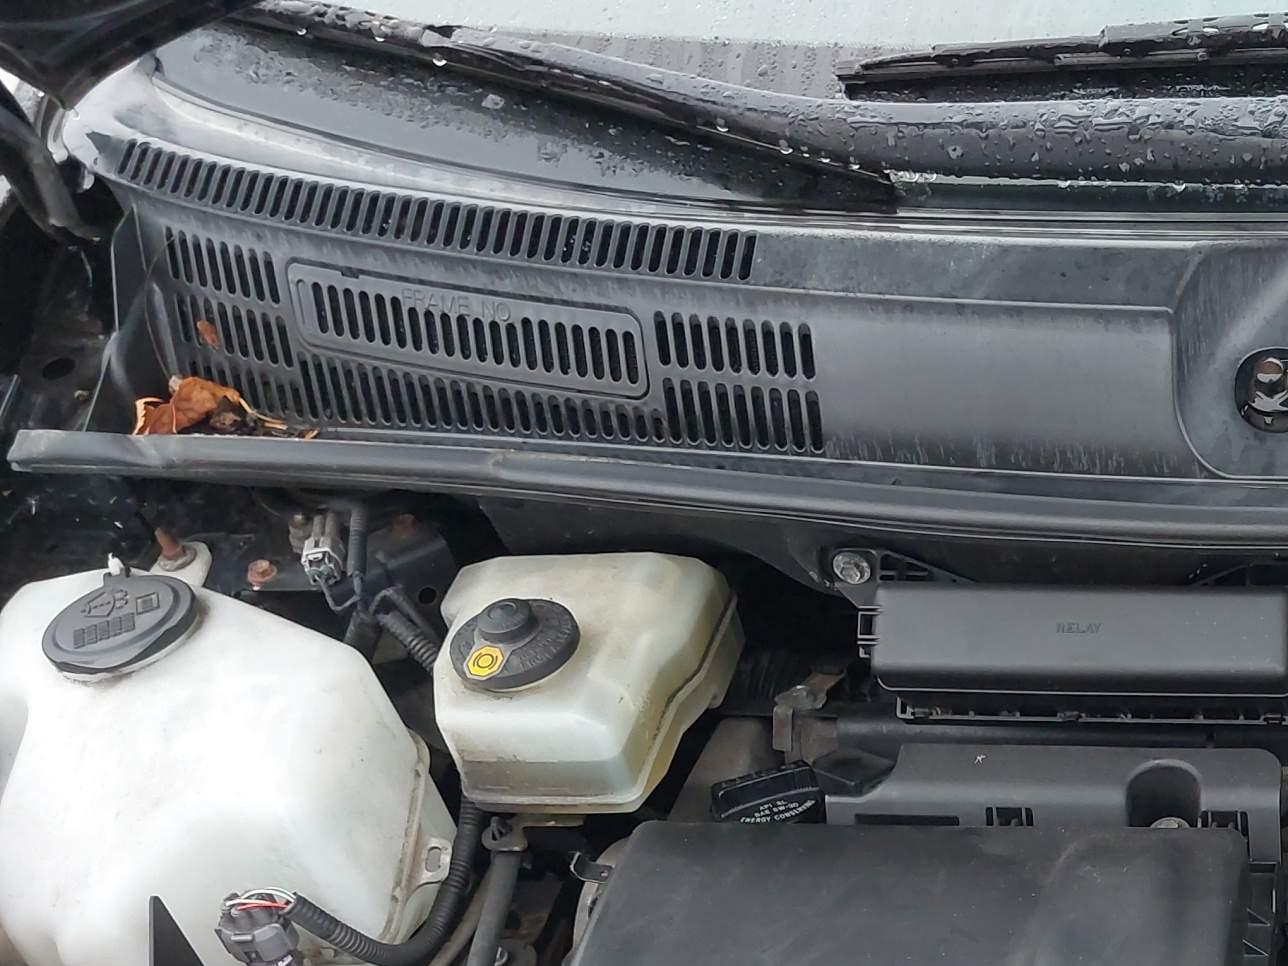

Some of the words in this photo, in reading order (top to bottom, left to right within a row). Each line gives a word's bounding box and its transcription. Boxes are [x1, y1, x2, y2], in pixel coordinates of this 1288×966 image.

[401, 288, 471, 317] FRAME
[1056, 622, 1103, 634] RELAY
[759, 803, 773, 811] API
[754, 809, 771, 818] SAE
